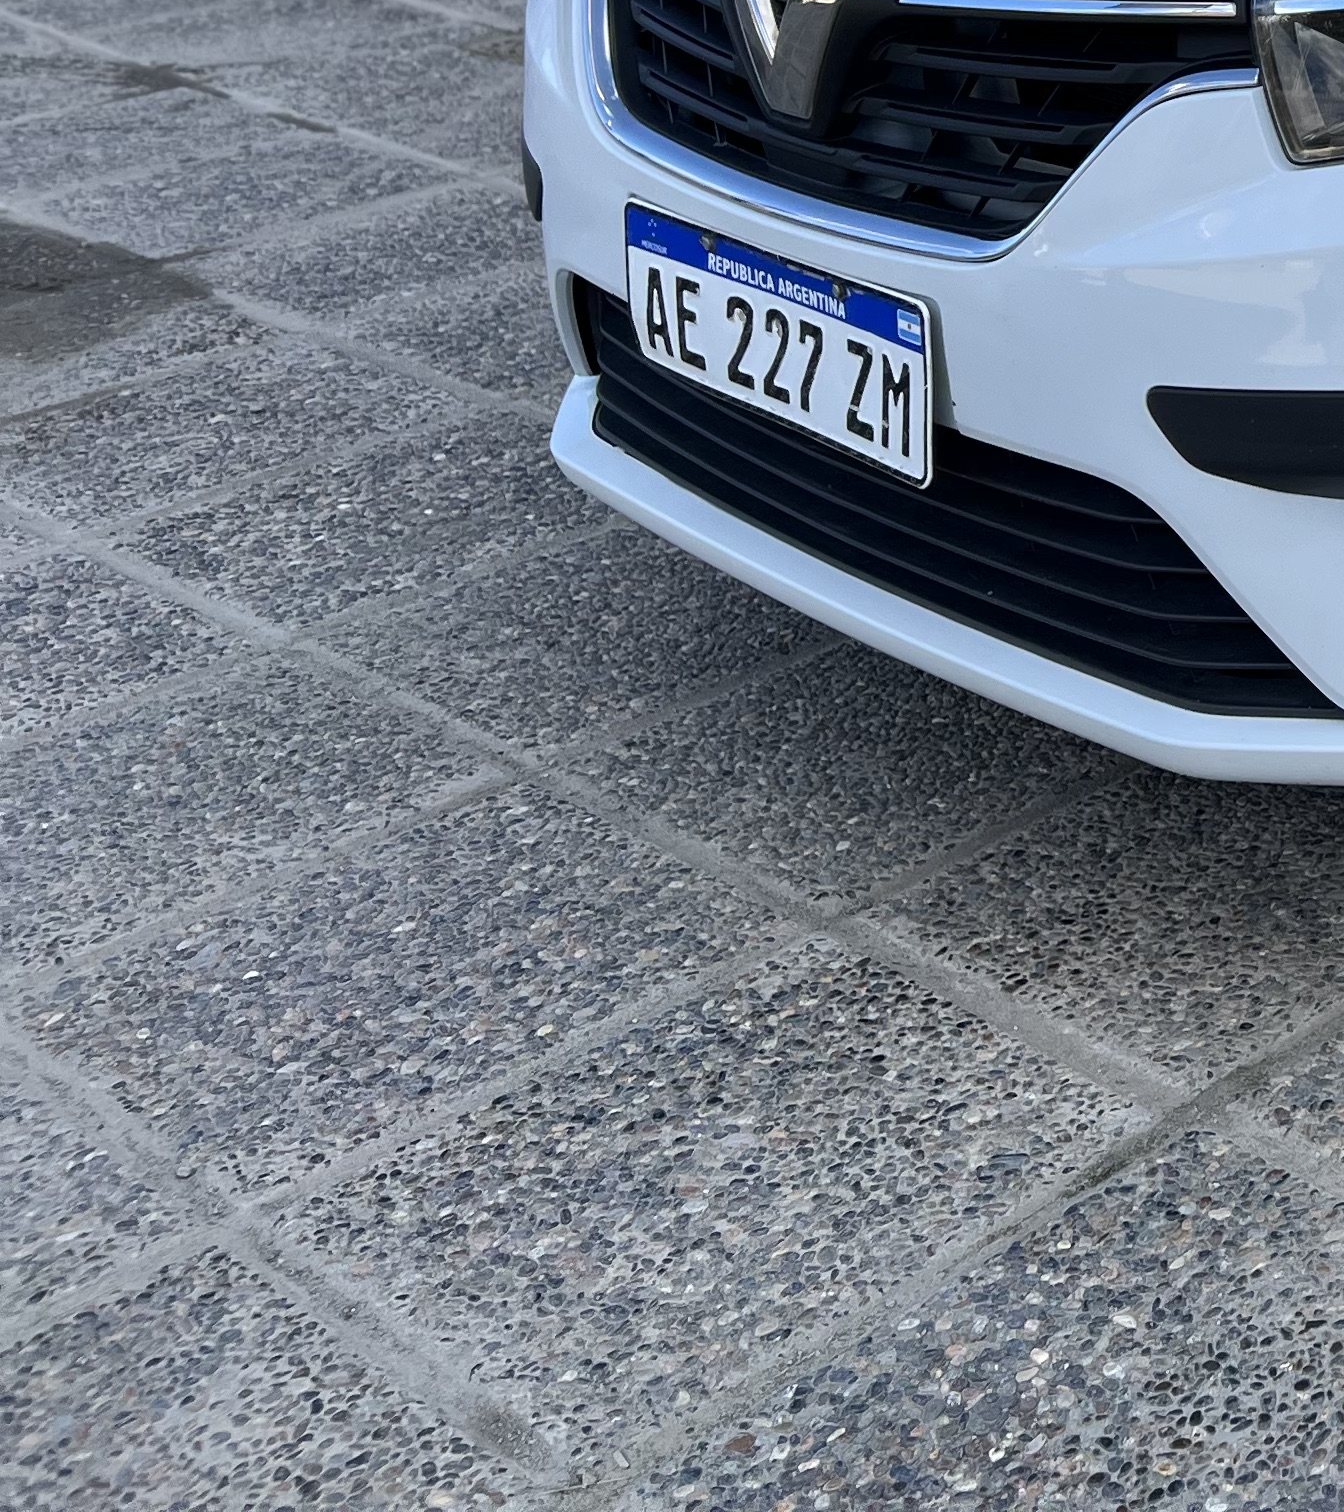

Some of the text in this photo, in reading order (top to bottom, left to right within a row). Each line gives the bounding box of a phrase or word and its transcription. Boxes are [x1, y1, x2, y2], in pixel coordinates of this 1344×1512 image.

[707, 252, 846, 319] REPUBLICA ARGENTINA
[646, 266, 911, 458] AE 227 ZM
